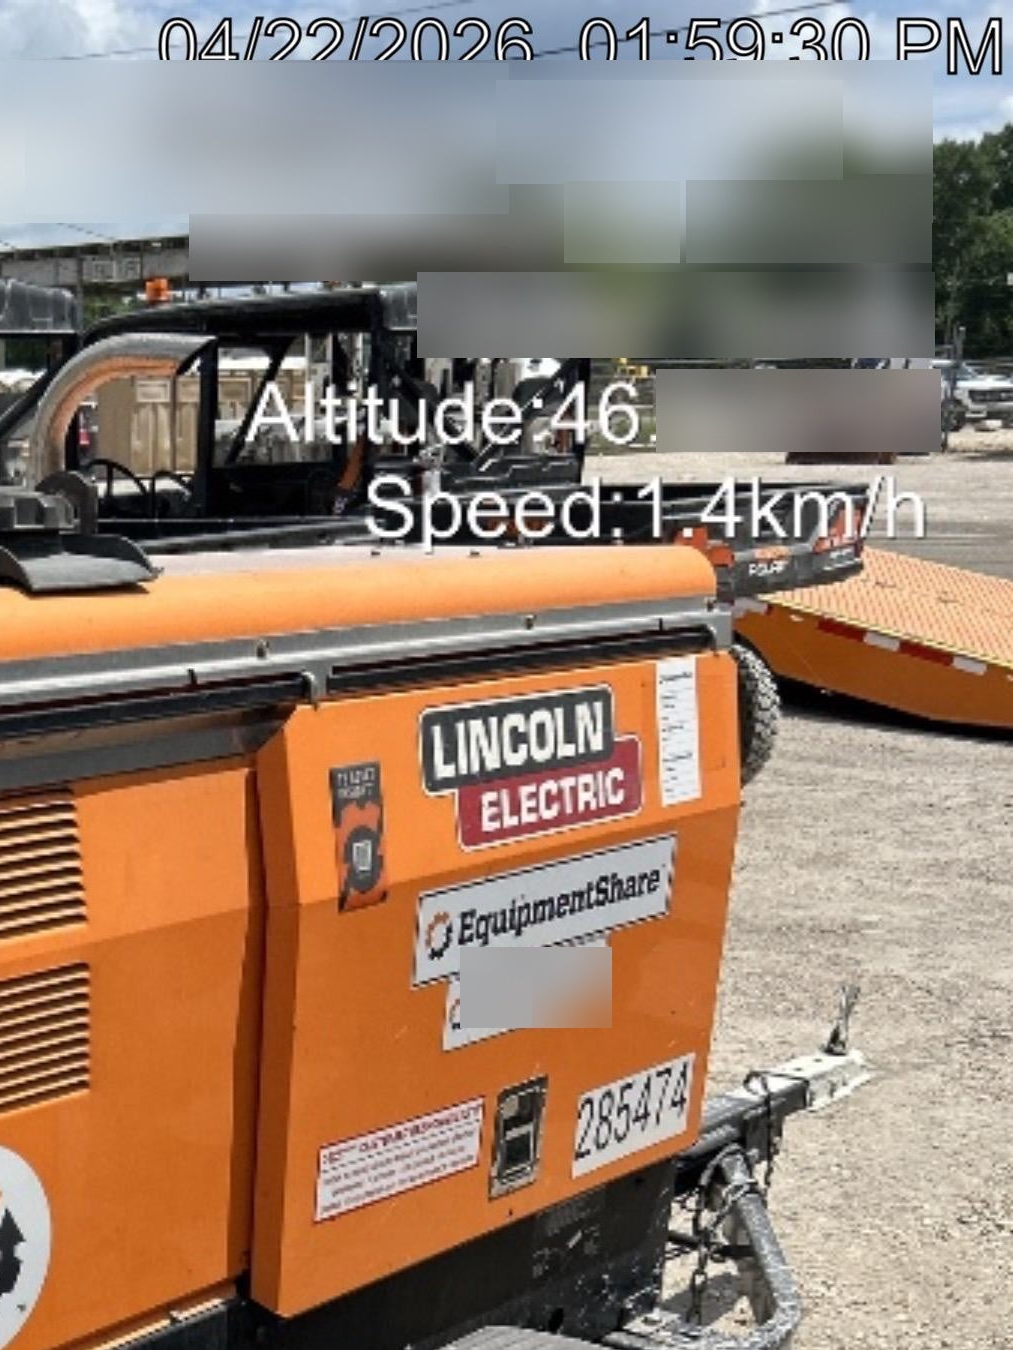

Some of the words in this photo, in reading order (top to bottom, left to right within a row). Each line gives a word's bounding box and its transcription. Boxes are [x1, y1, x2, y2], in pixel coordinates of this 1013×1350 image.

[432, 700, 605, 779] LINCOLN
[480, 767, 626, 832] ELECTRIC
[456, 868, 661, 947] EquipmentShare
[574, 1061, 688, 1161] 285474
